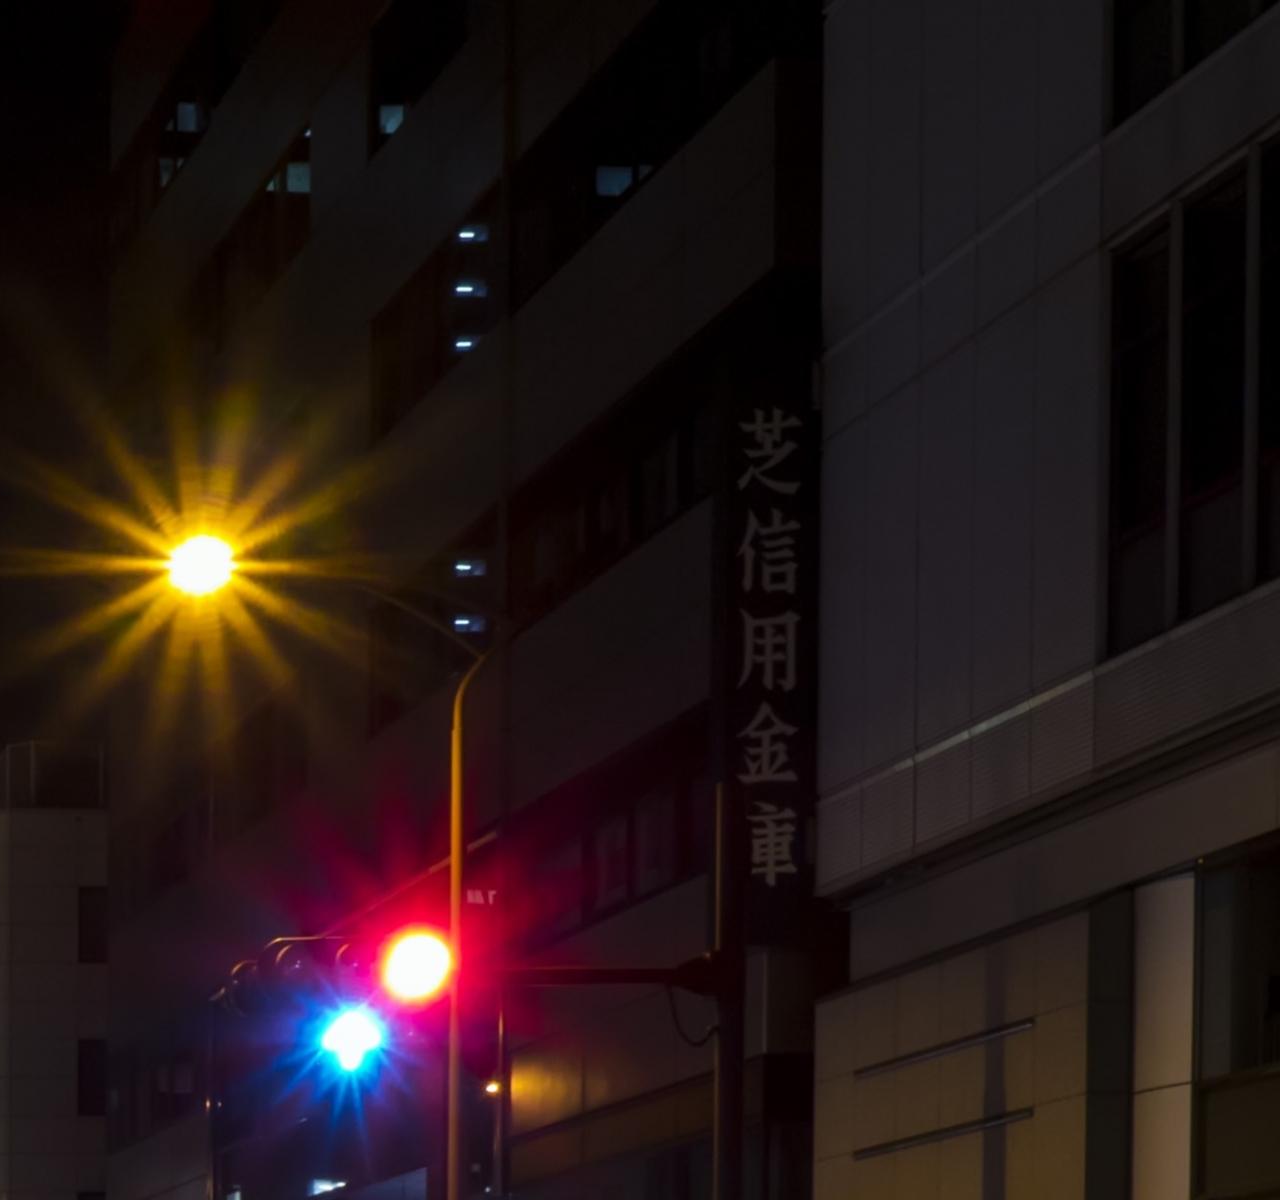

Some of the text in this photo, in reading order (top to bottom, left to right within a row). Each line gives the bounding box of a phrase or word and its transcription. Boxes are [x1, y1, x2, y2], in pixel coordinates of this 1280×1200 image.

[736, 406, 804, 889] 芝信用金庫
